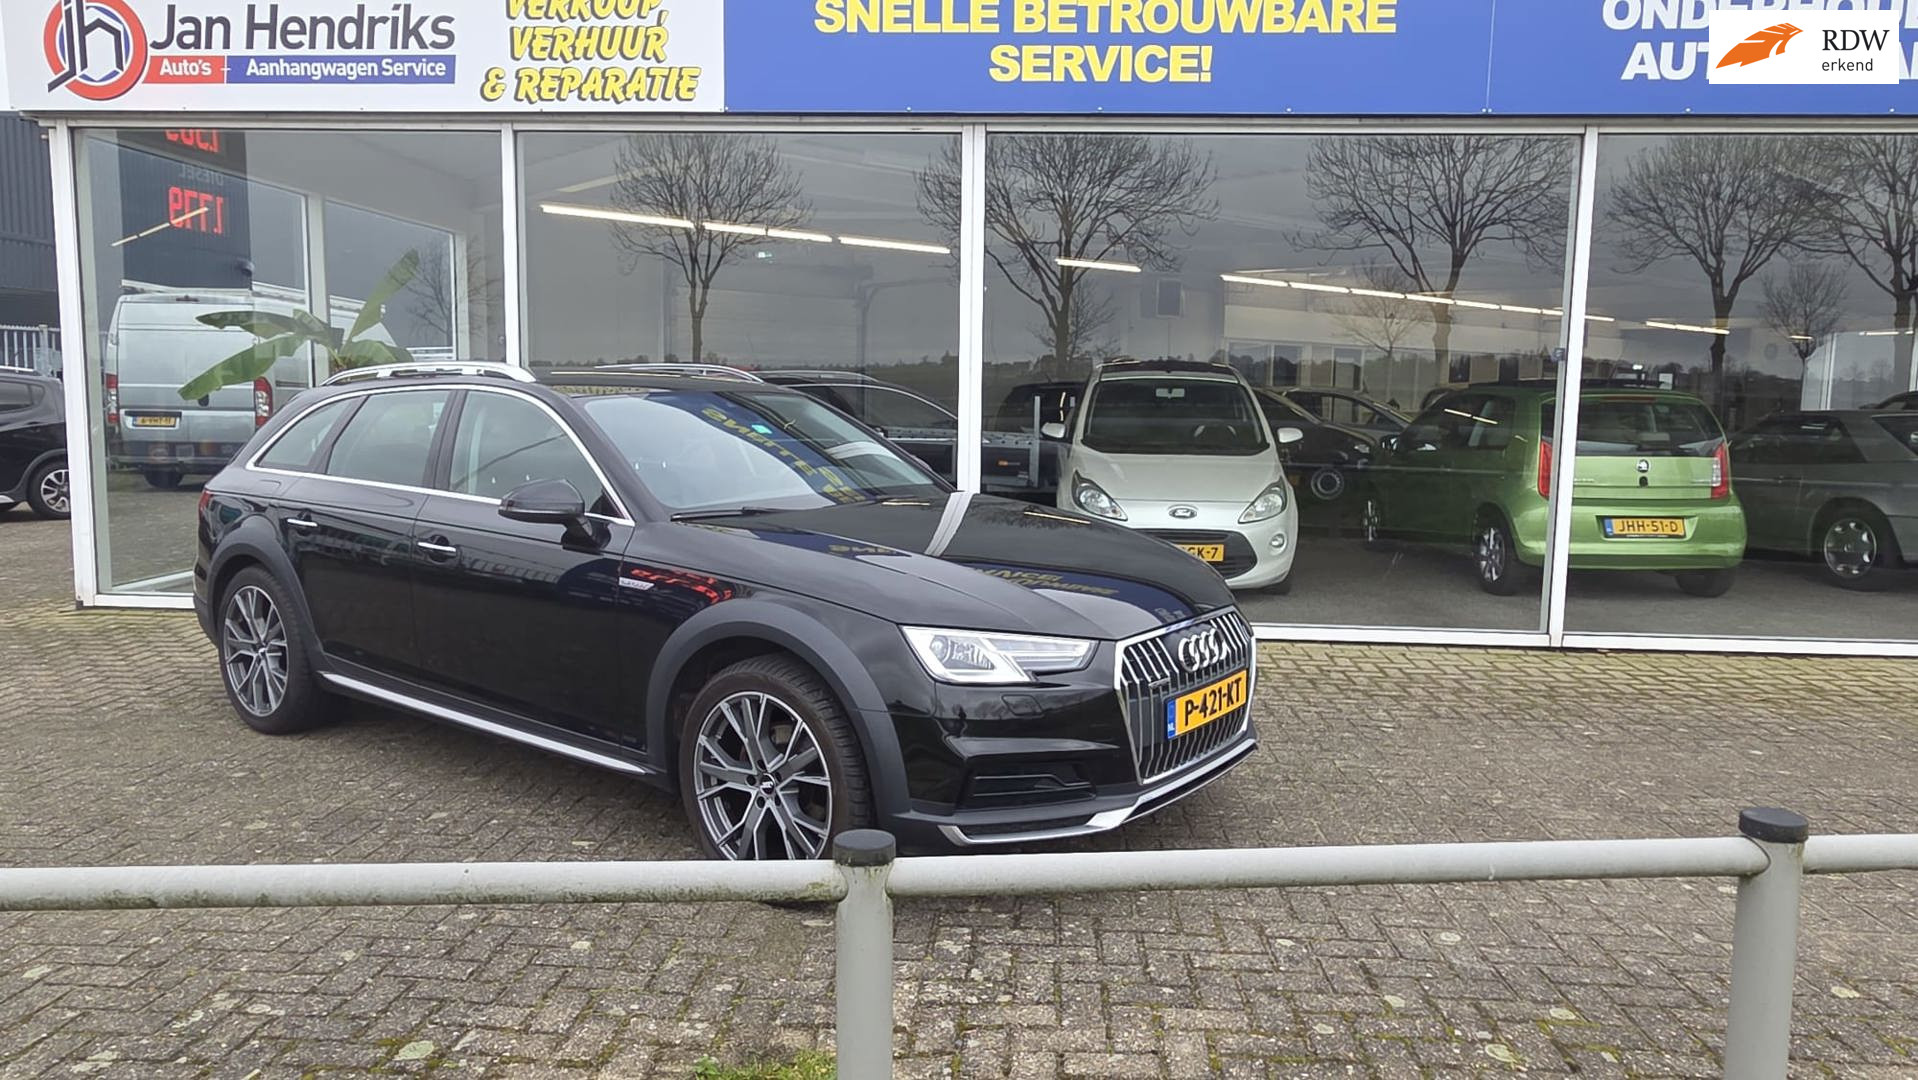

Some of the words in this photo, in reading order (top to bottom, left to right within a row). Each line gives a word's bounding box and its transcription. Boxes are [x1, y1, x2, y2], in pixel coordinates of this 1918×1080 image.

[150, 4, 231, 50] Jan
[245, 3, 456, 50] Hendriks
[814, 0, 1000, 33] SNELLE
[1013, 0, 1397, 33] BETROUWBARE
[510, 26, 669, 63] VERHUUR
[160, 58, 212, 76] Auto's
[246, 58, 378, 80] Aanhangwagen
[381, 58, 447, 77] Service
[989, 45, 1212, 82] SERVICE!
[480, 67, 507, 101] &
[514, 67, 701, 104] REPARATIE
[1619, 520, 1679, 533] JHH-51-D
[1184, 677, 1242, 727] P-421-KT
